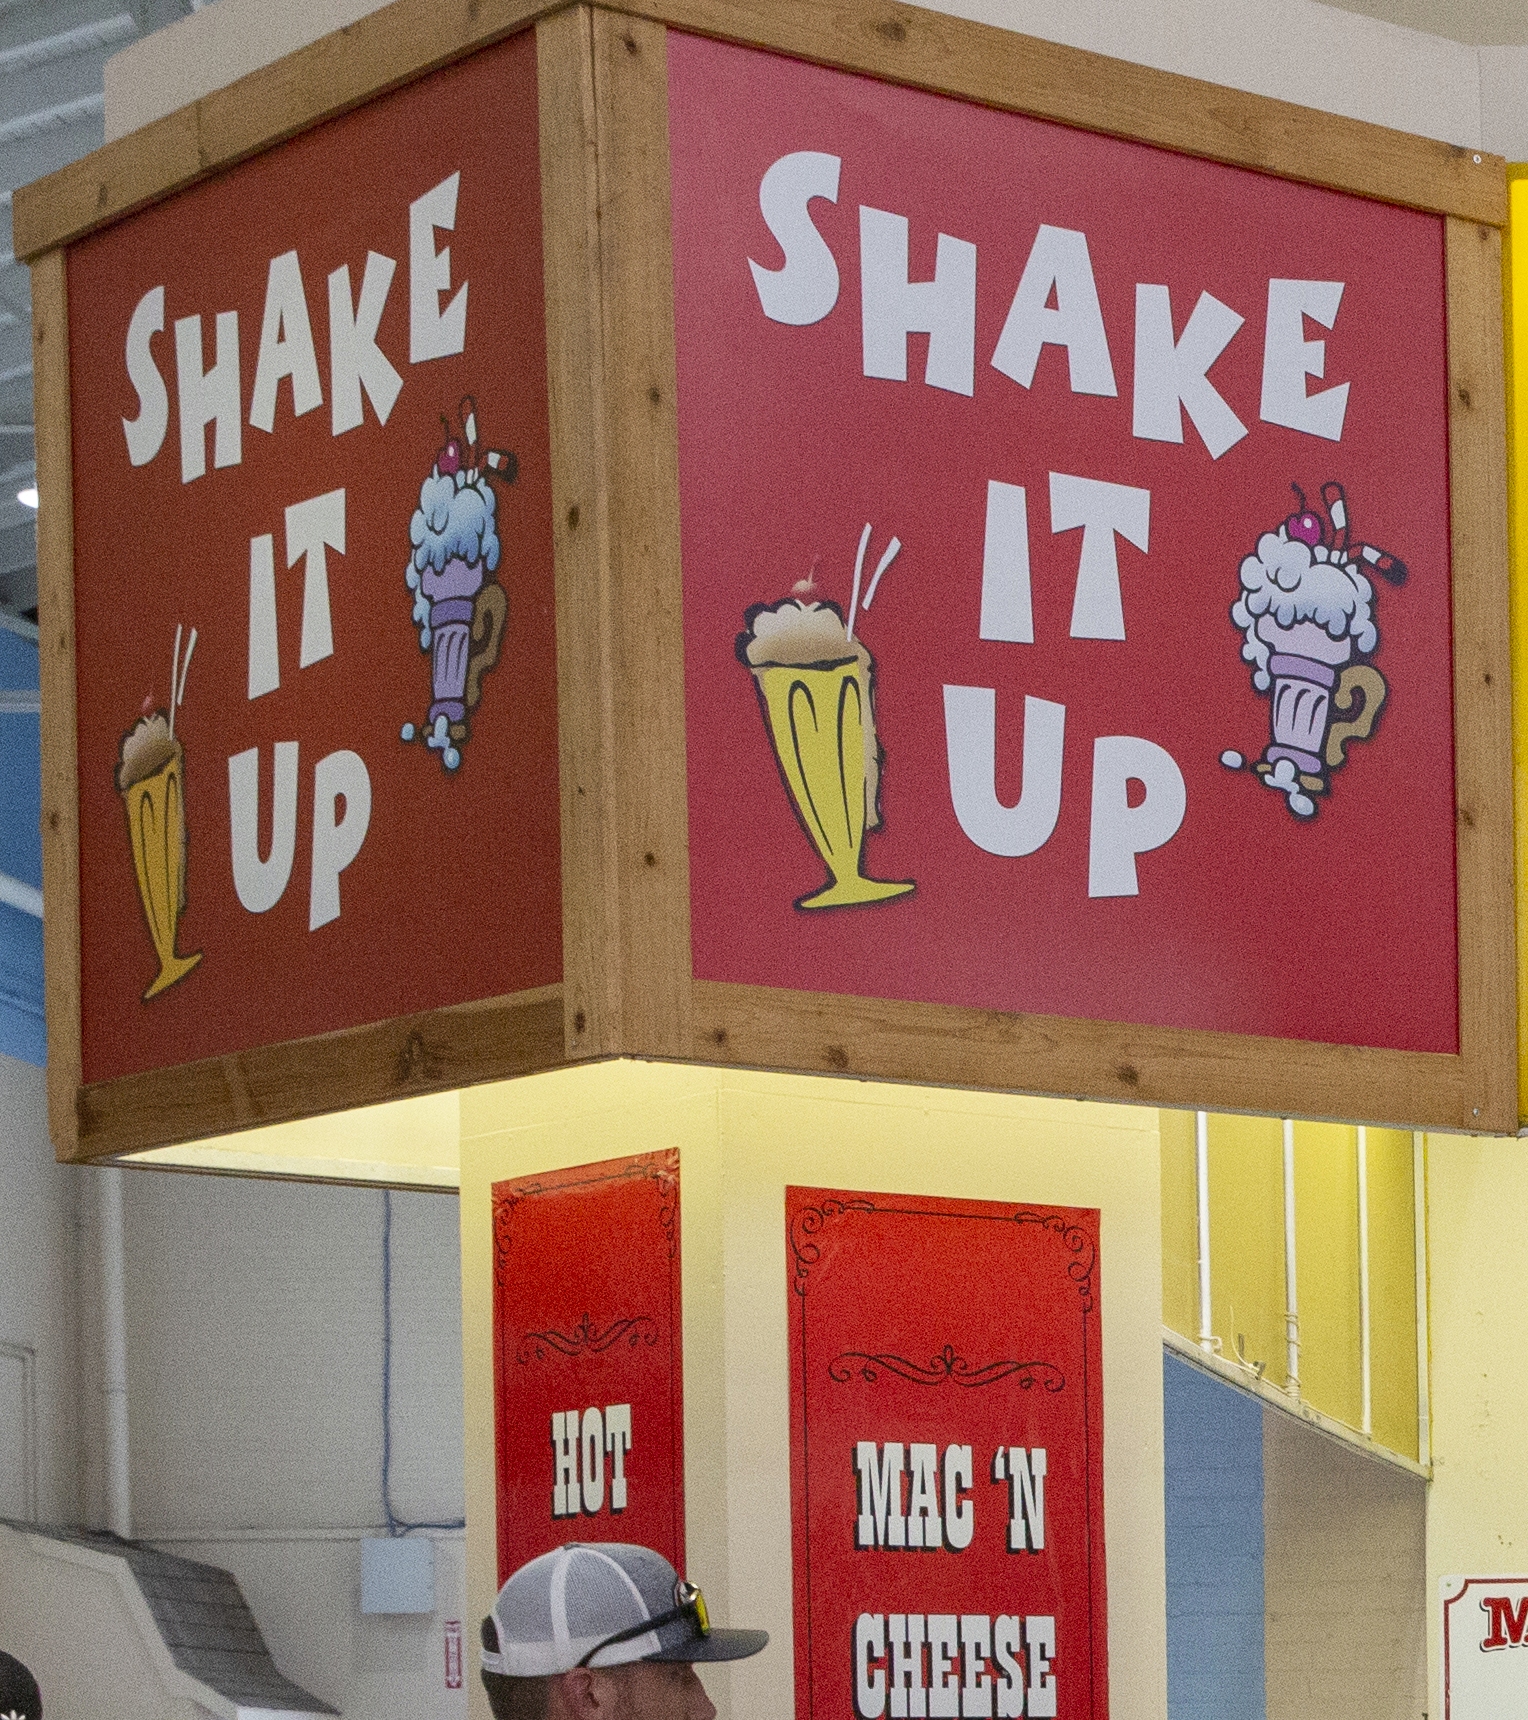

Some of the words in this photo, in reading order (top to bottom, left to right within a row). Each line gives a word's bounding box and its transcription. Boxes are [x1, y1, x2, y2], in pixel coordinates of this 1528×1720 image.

[121, 171, 469, 483] SHAKE
[747, 151, 1351, 459] SHAKE
[248, 489, 346, 700] IT
[980, 471, 1150, 643] IT
[228, 741, 372, 931] UP
[943, 684, 1187, 897] UP
[551, 1404, 633, 1518] HOT
[854, 1442, 973, 1551] MAC
